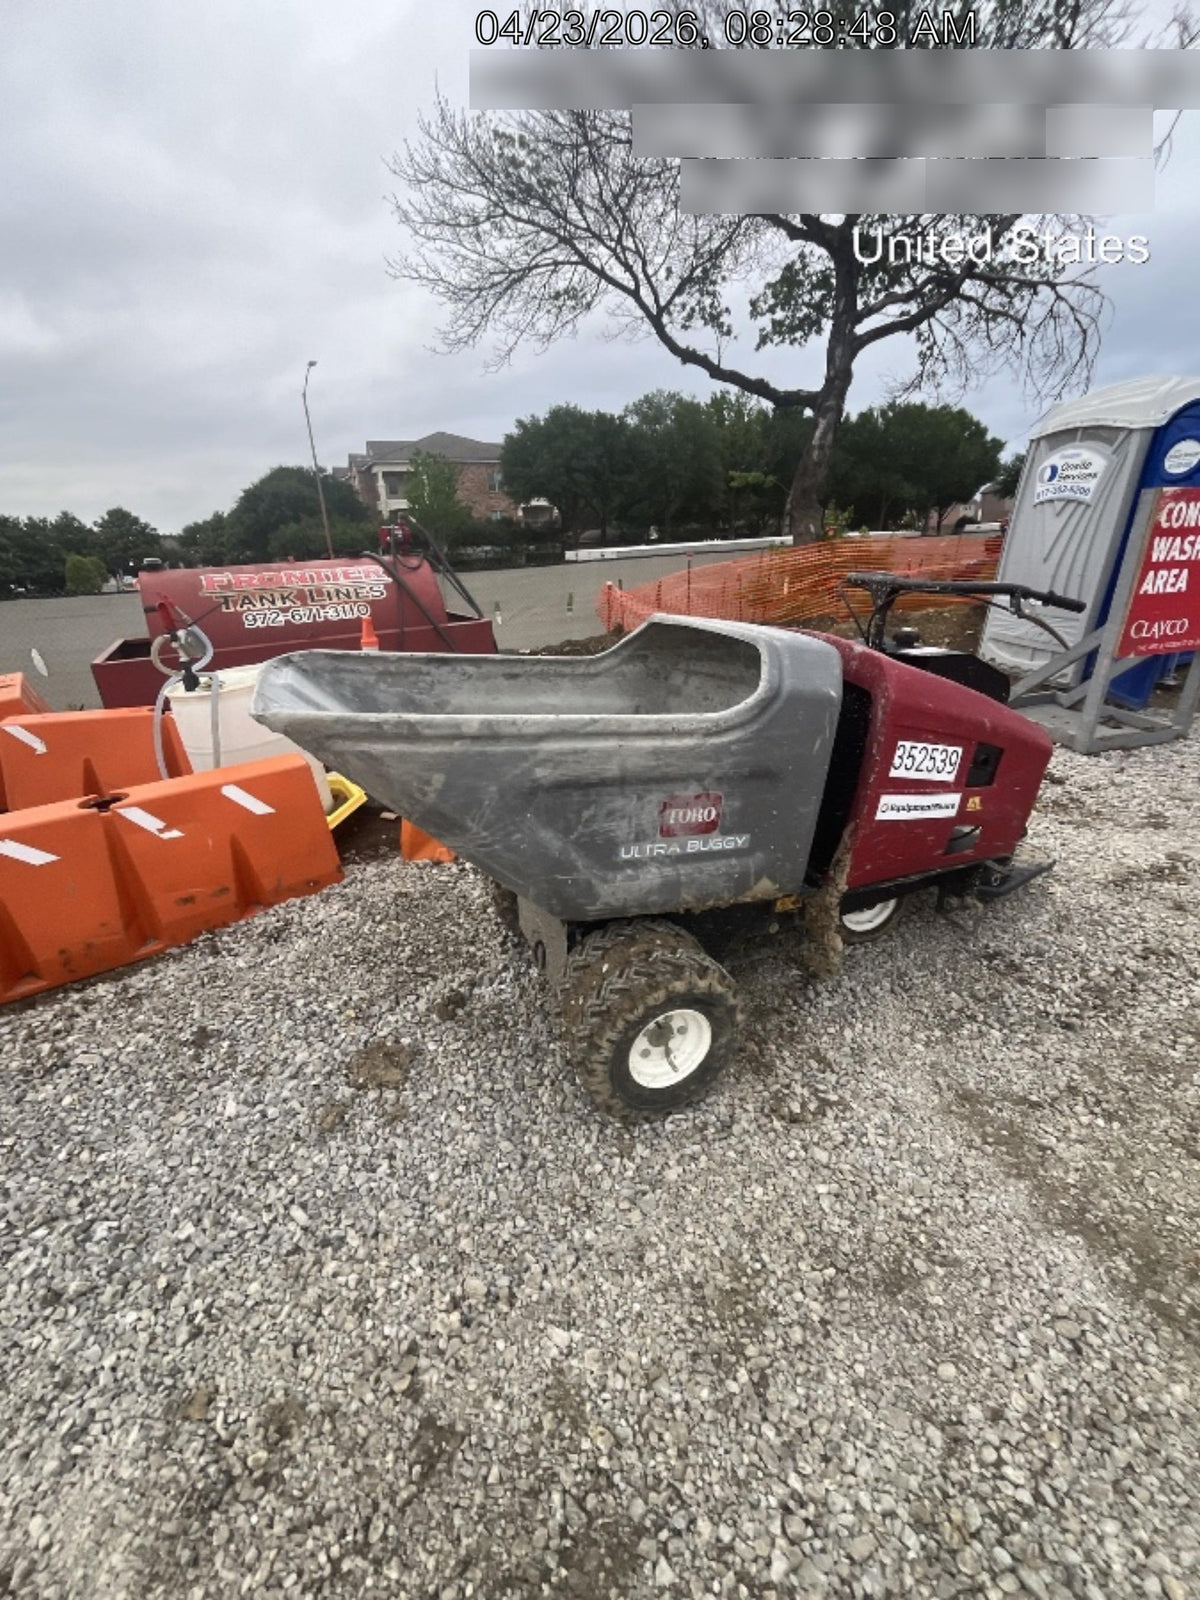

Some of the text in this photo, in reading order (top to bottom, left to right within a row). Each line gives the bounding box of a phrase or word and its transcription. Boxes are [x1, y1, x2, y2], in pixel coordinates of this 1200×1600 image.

[1161, 501, 1200, 528] CON
[201, 566, 393, 595] FRONTIER
[1140, 568, 1188, 594] AREA
[215, 584, 386, 611] TANK LINES
[243, 603, 369, 628] 972-671-3110
[1130, 618, 1189, 639] CLAYCO
[892, 744, 959, 774] 352539
[669, 806, 717, 824] TORO
[621, 836, 746, 858] ULTRA BUGGY
